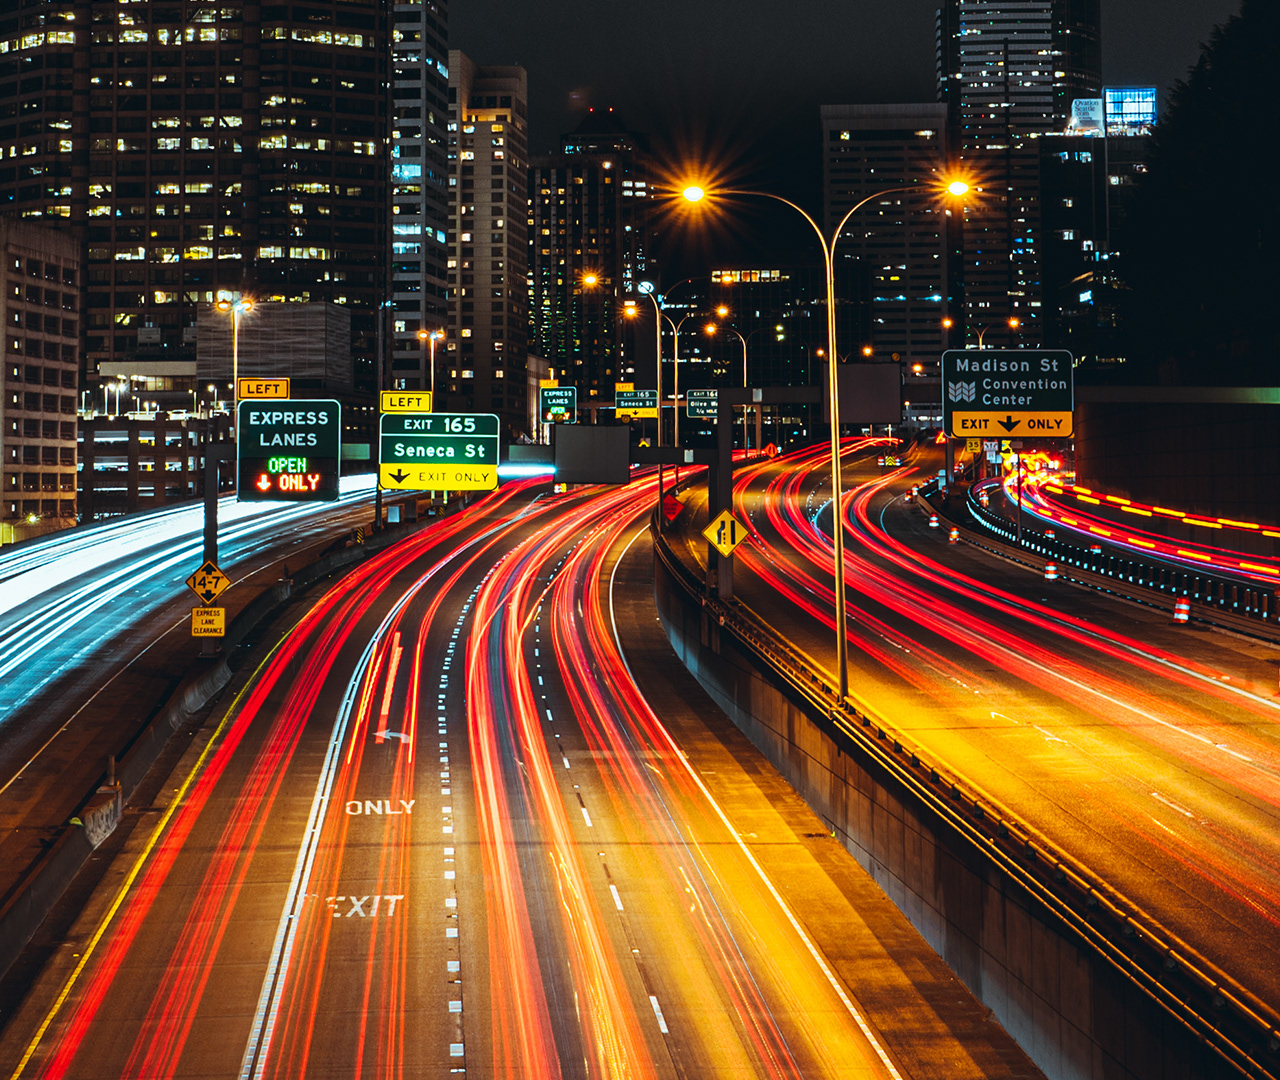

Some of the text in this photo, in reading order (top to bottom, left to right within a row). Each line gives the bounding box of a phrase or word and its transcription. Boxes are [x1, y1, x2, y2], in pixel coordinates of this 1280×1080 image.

[956, 358, 1059, 372] Madison St
[247, 384, 280, 394] LEFT
[982, 378, 1067, 390] Convention
[390, 397, 422, 407] LEFT
[982, 393, 1033, 405] Center
[249, 411, 329, 425] EXPRESS
[404, 417, 476, 432] EXIT 165
[961, 419, 1063, 429] EXIT ONLY
[260, 433, 318, 446] LANES
[394, 443, 485, 458] Seneca St
[268, 457, 307, 473] OPEN
[279, 474, 320, 491] ONLY
[419, 472, 489, 482] EXIT ONLY
[345, 799, 415, 815] ONLY
[325, 895, 404, 917] EXIT
